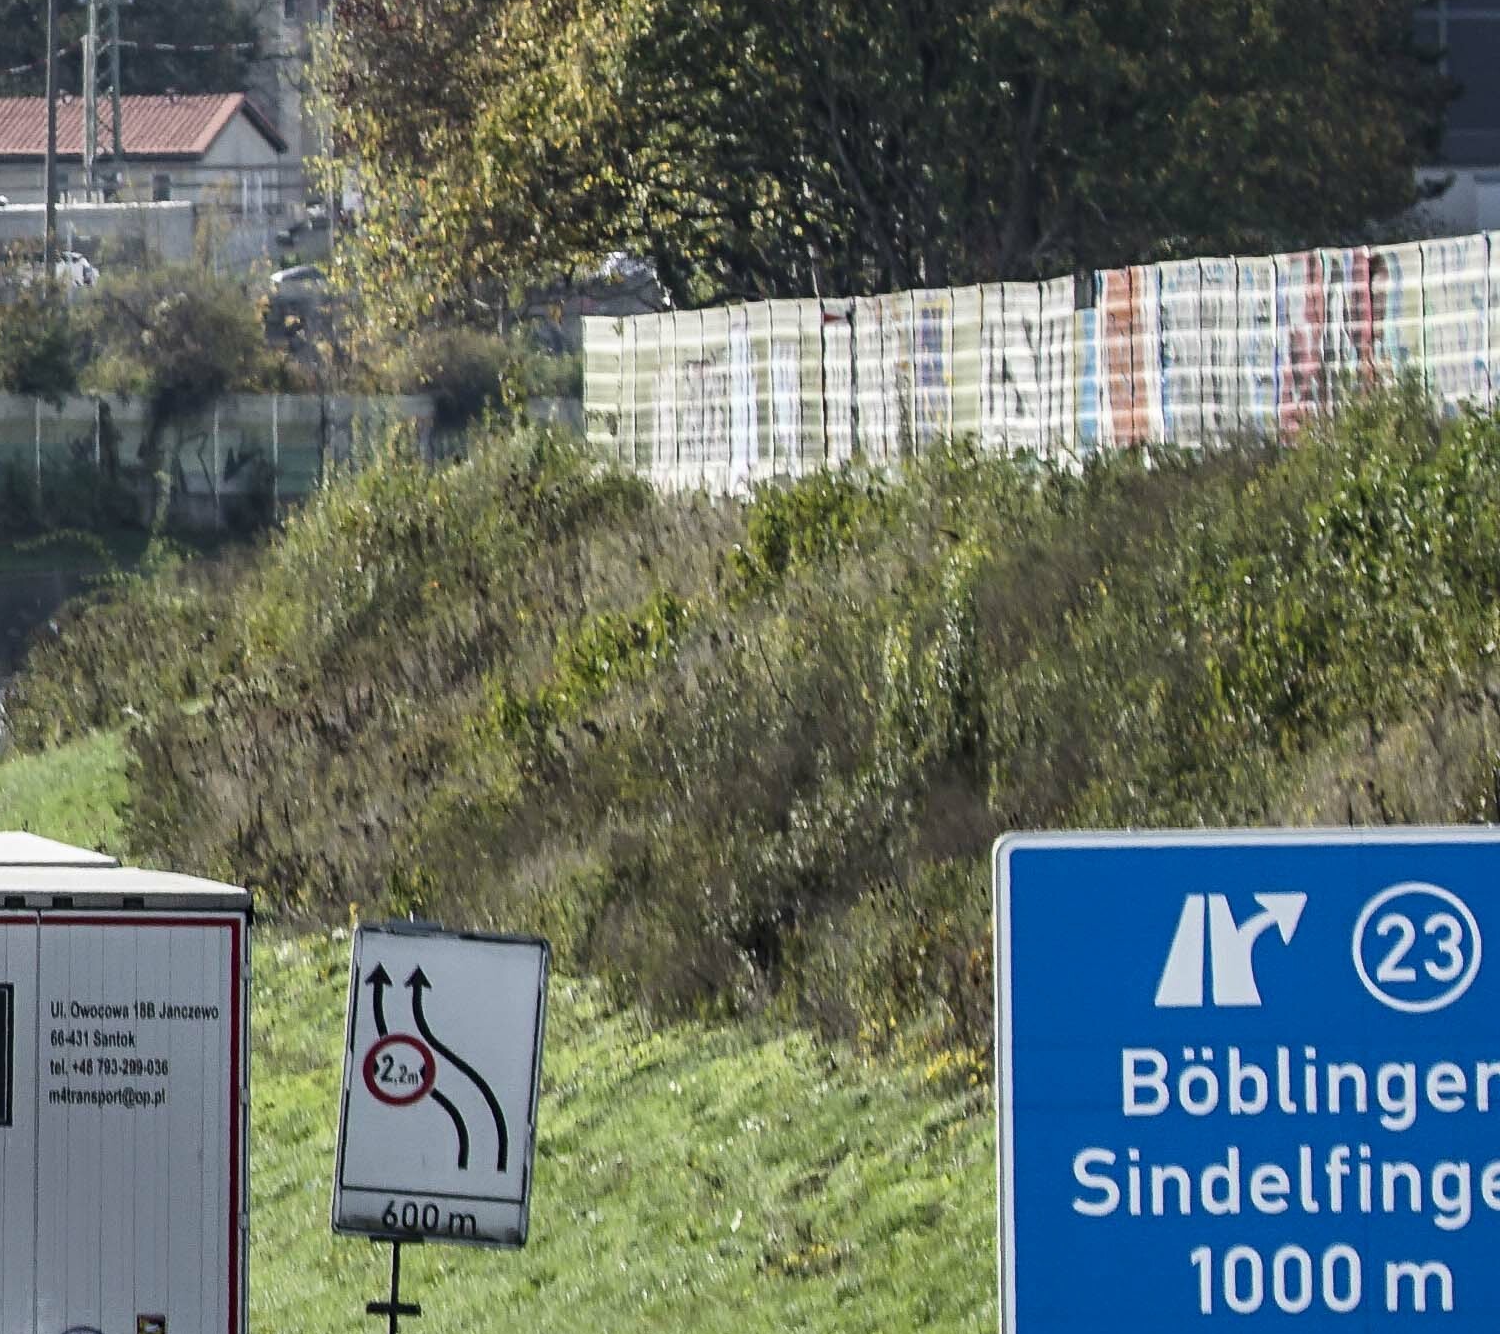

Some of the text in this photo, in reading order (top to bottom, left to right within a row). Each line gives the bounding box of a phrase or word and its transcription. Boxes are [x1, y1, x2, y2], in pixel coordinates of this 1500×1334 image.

[1375, 913, 1465, 982] 23
[70, 1001, 129, 1019] Owocowa
[134, 1001, 156, 1019] 18B
[159, 1001, 220, 1020] Janczewo
[50, 1028, 135, 1048] 66-431 Santok
[72, 1058, 94, 1076] +48
[380, 1053, 420, 1086] 2,2m
[49, 1085, 166, 1109] m4transport@op.pl
[381, 1199, 477, 1236] 600 m
[1190, 1242, 1455, 1316] 1000 m
